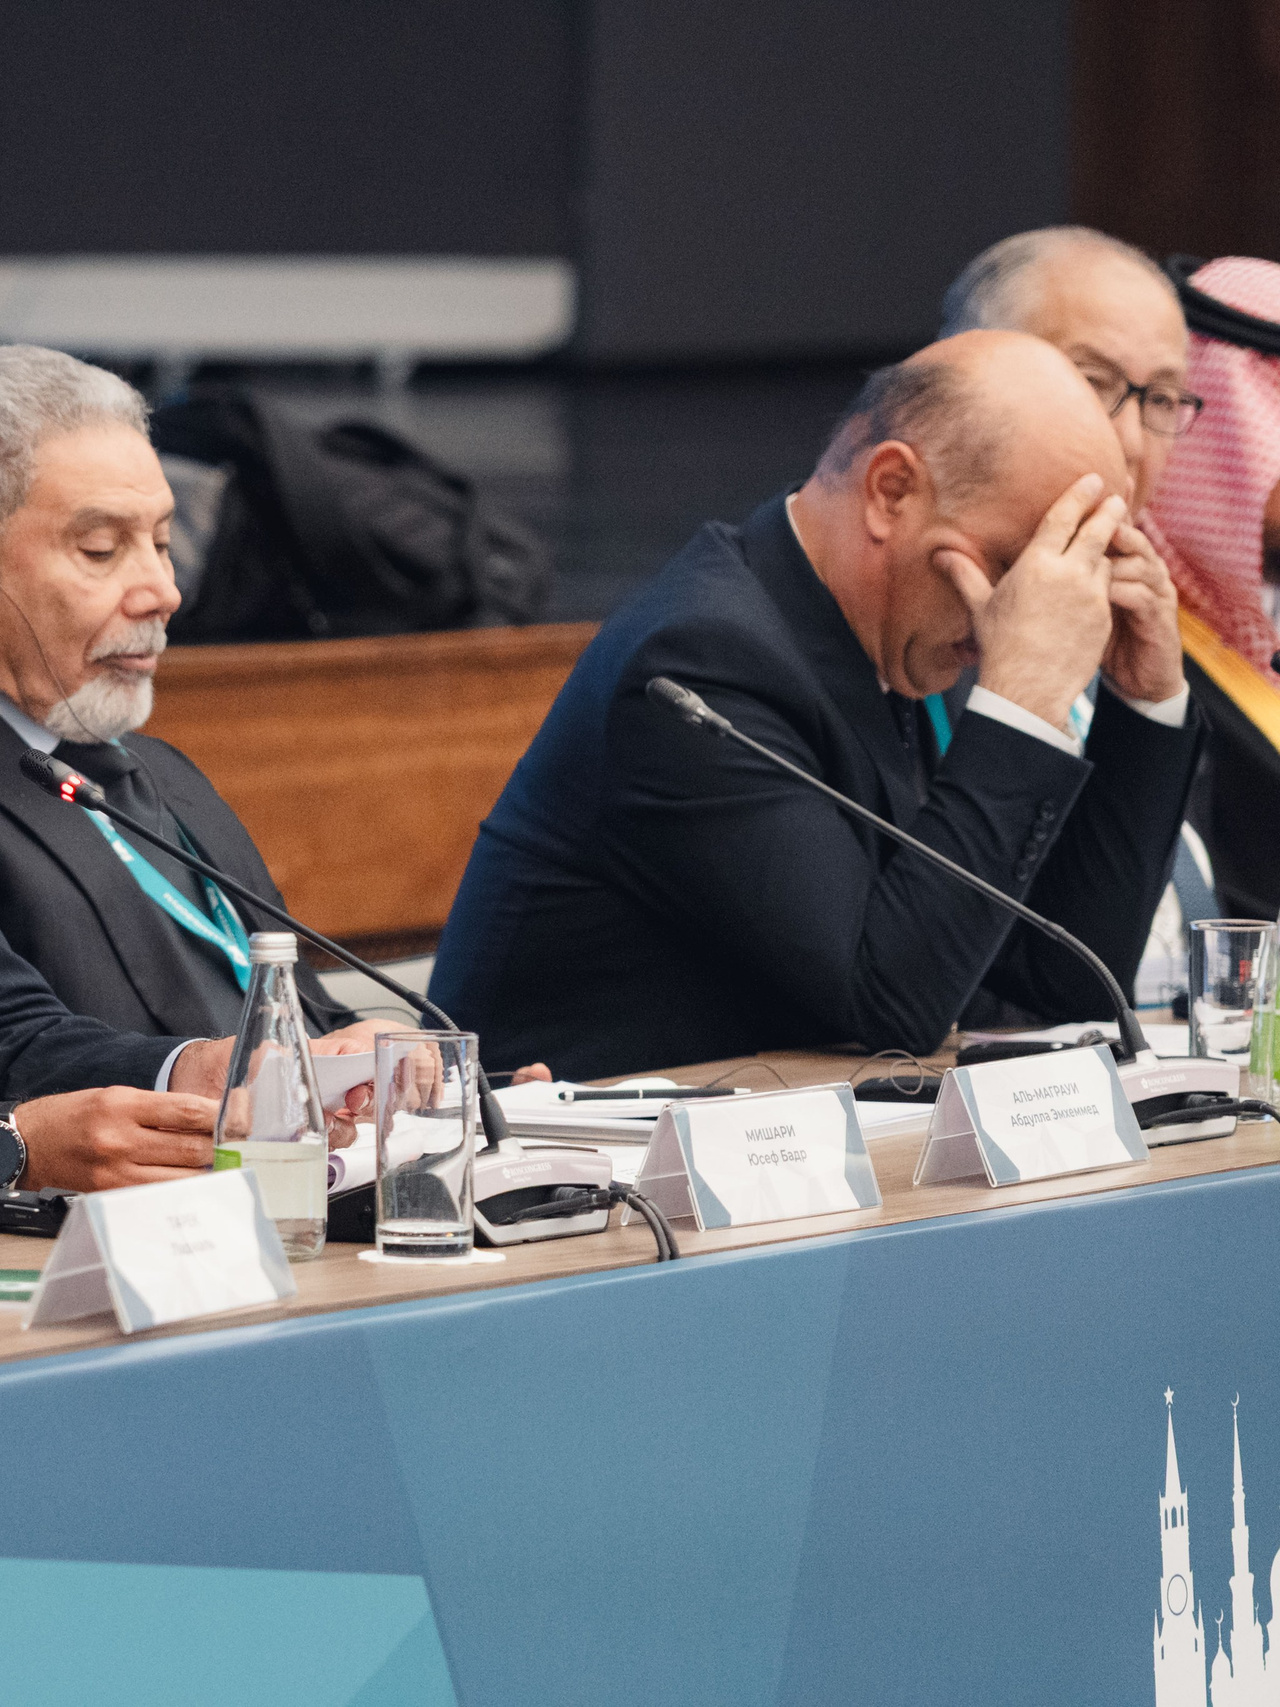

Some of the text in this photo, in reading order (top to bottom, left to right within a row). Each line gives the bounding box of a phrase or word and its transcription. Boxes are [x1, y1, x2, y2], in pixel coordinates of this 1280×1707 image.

[1012, 1082, 1080, 1104] АЛЬ-МАГРАУИ
[1010, 1104, 1100, 1127] Абдулла Эмхеммед
[745, 1124, 796, 1142] МИШАРИ
[747, 1149, 807, 1166] Юсеф Бадр
